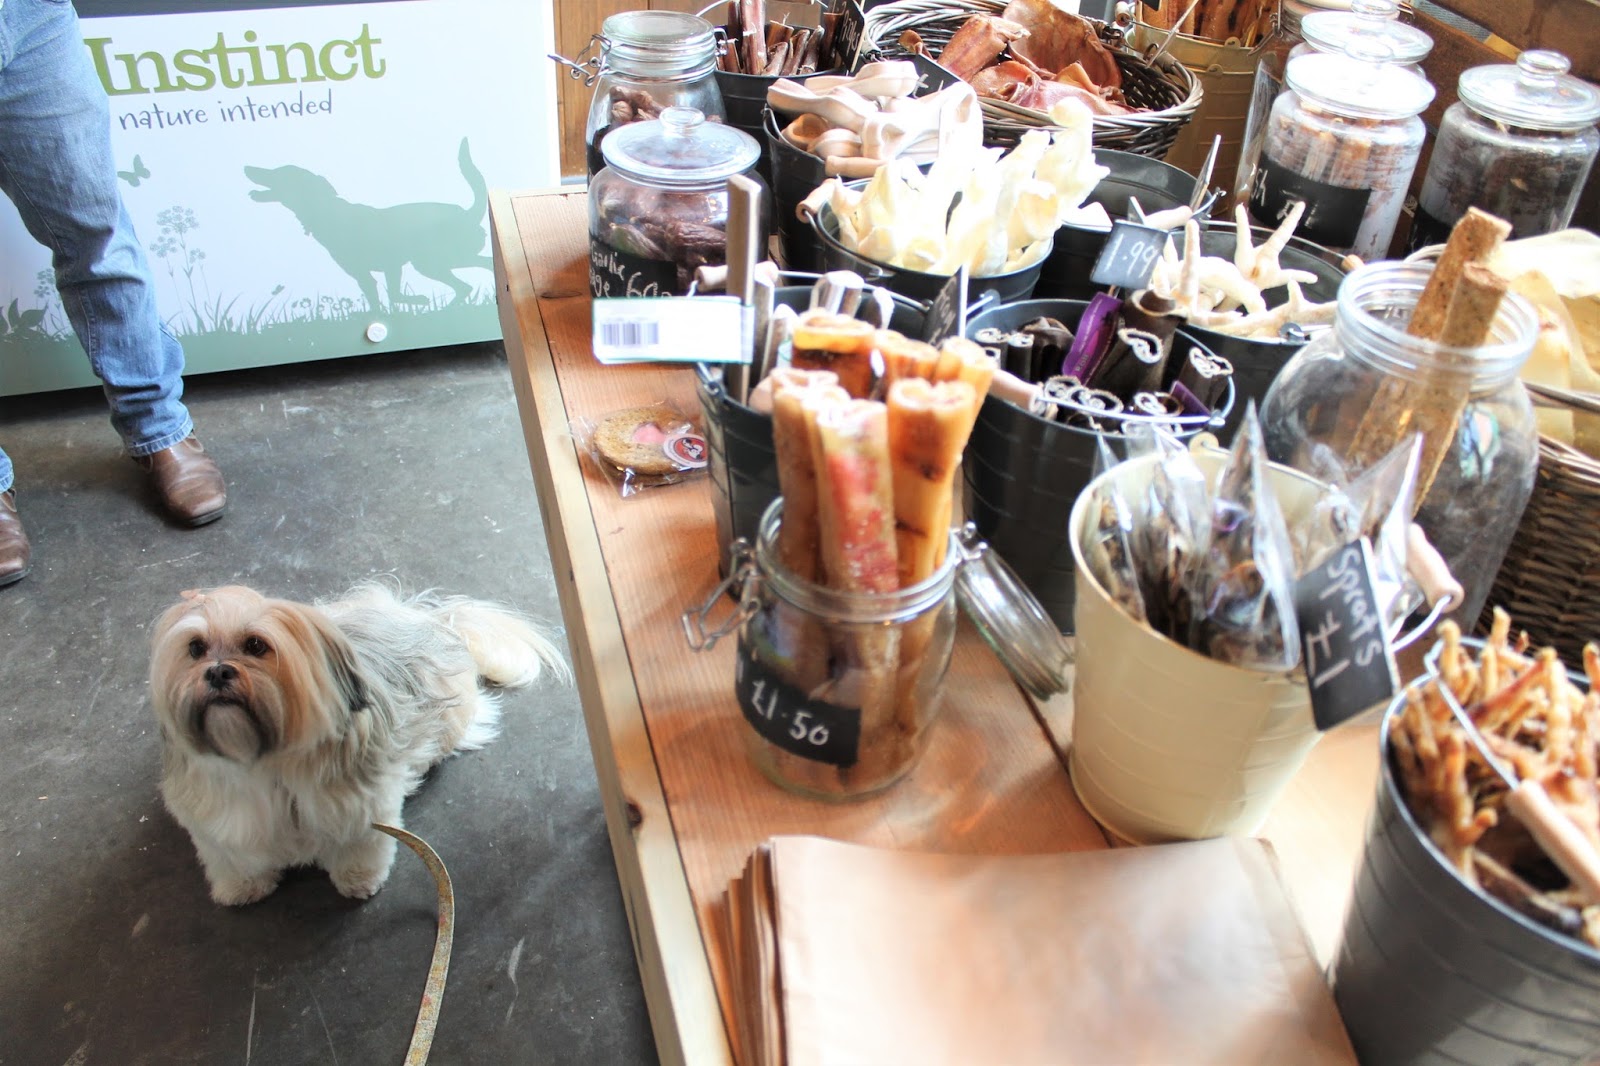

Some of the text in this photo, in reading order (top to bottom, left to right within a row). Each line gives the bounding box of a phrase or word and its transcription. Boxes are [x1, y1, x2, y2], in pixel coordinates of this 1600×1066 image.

[83, 23, 387, 97] Instinct
[119, 88, 333, 130] nature intended
[1319, 547, 1383, 667] Sprats
